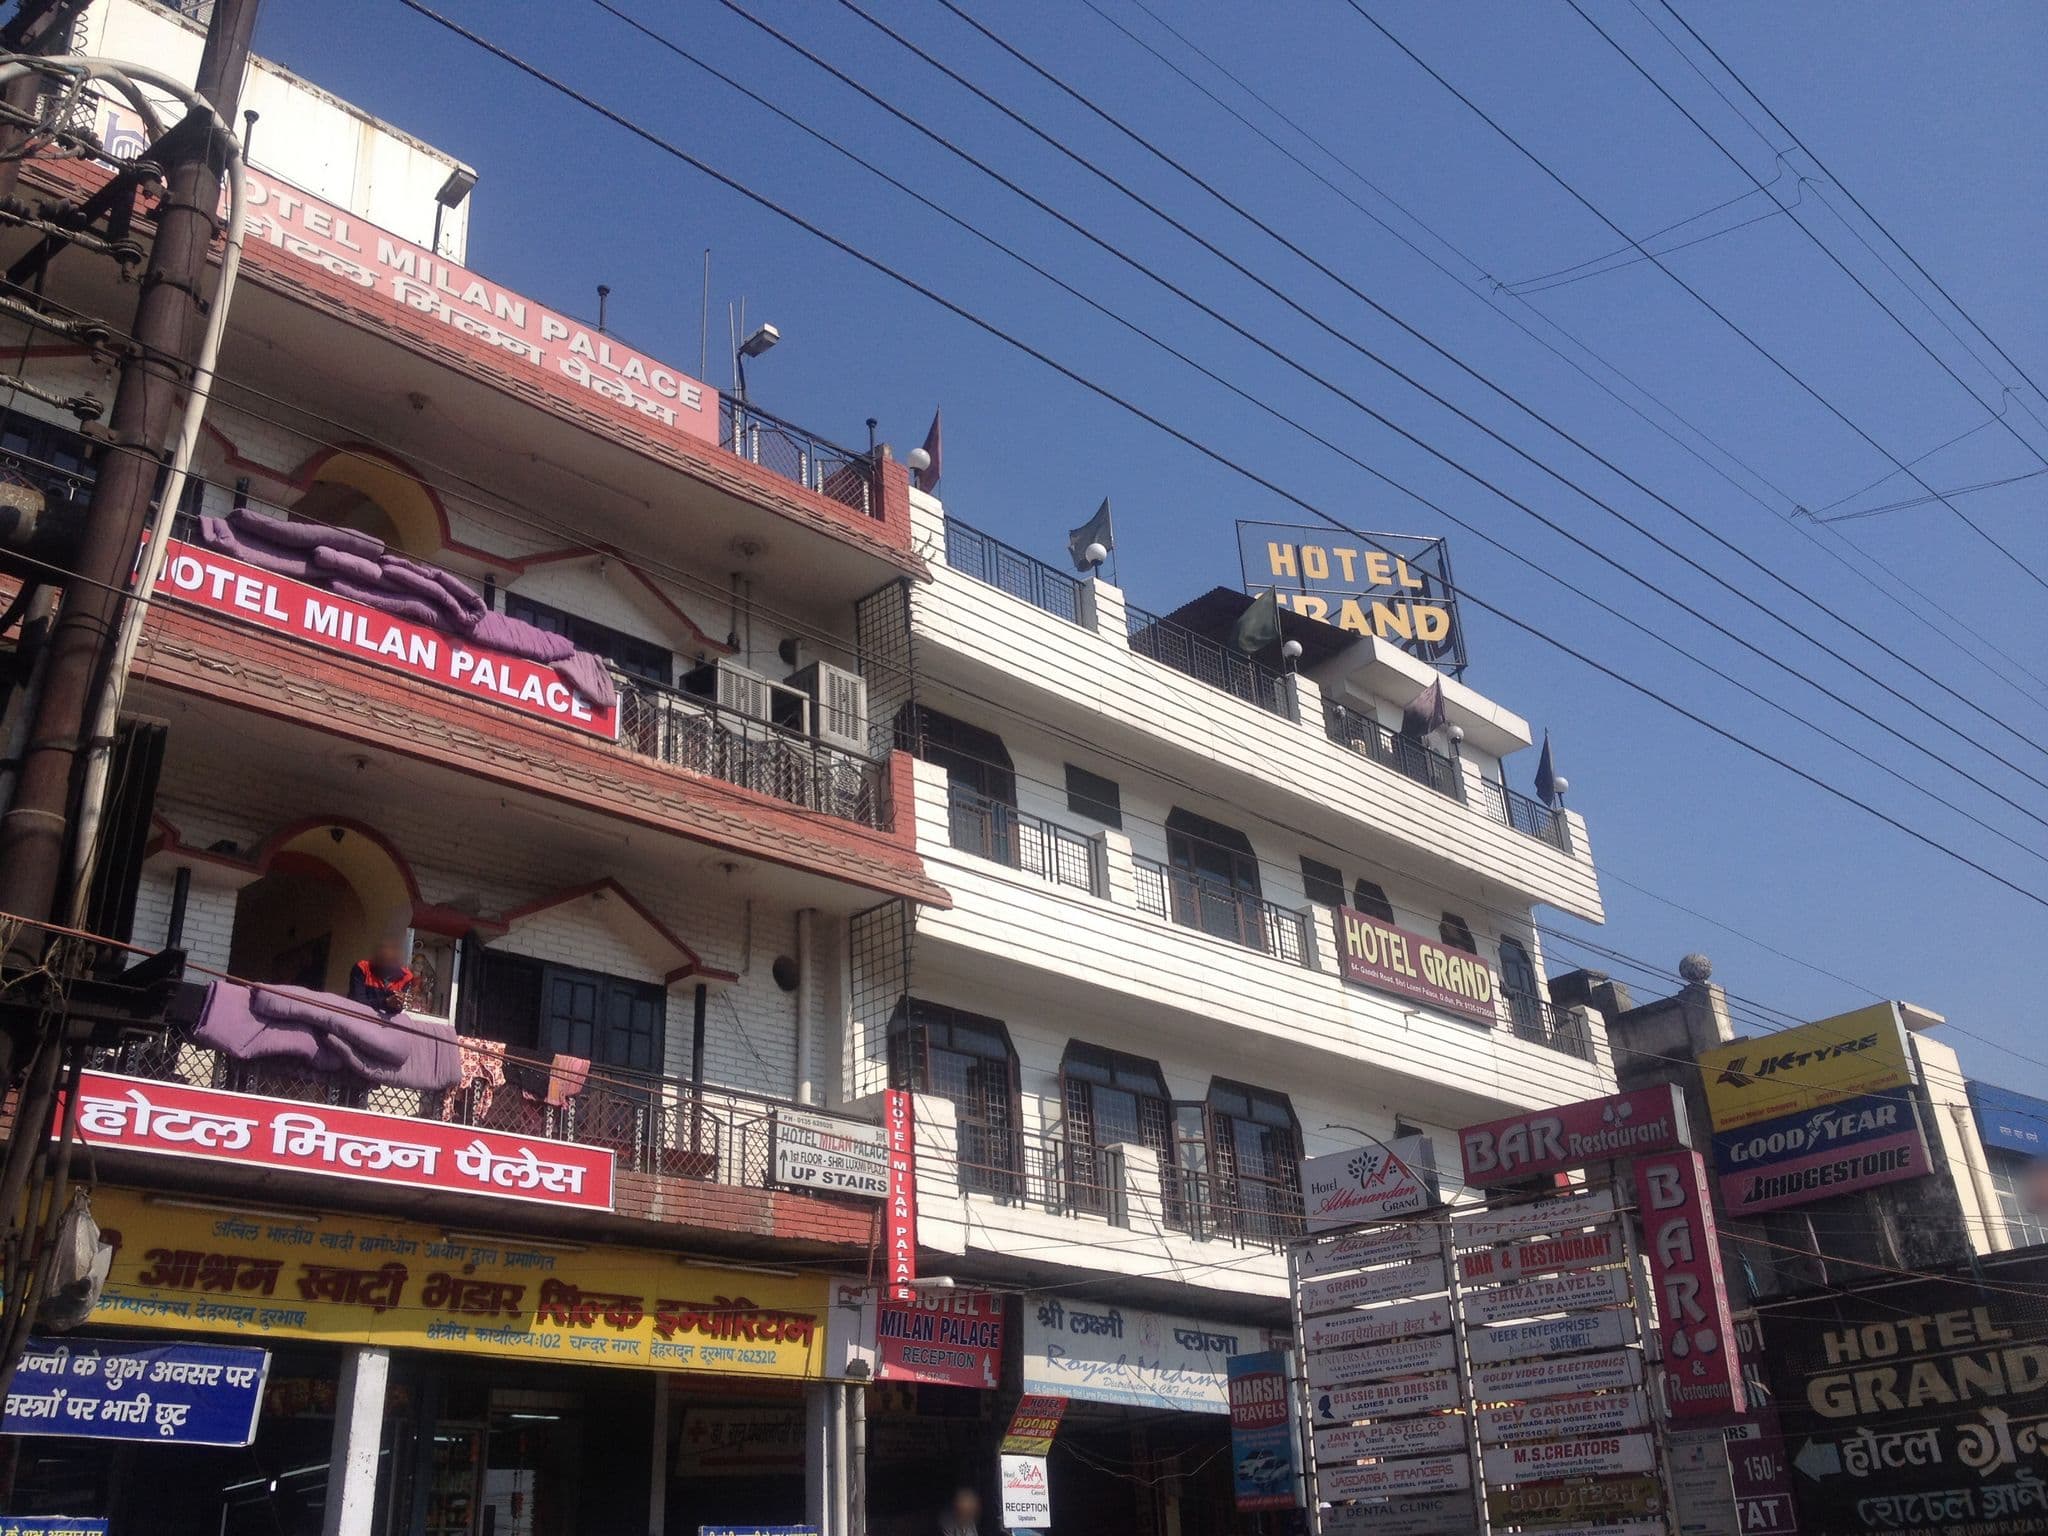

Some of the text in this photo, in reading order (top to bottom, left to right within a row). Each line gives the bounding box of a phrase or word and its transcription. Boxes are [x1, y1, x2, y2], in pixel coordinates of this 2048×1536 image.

[242, 176, 702, 413] OTEL MILAN PALACE
[391, 276, 547, 366] मिलन
[1267, 542, 1423, 588] HOTEL
[1254, 592, 1450, 642] RAND
[304, 599, 438, 671] MILAN
[450, 649, 592, 722] PALACE
[1344, 915, 1492, 1003] HOTEL GRAND
[80, 1090, 587, 1194] होटल मिलन पैलेस
[782, 1127, 817, 1149] HOTEL
[820, 1134, 853, 1153] MILAN
[853, 1140, 888, 1161] PALACE
[1464, 1117, 1669, 1174] BAR Restaurant
[790, 1150, 800, 1160] 1st
[801, 1152, 823, 1165] FLOOR
[829, 1156, 845, 1169] SHRI
[1743, 1146, 1911, 1204] BRIDGESTONE
[792, 1166, 888, 1192] UP STAIRS
[891, 1096, 909, 1299] HOTEL MILAN PALACE
[267, 1225, 316, 1247] भारतीय
[320, 1230, 356, 1252] खादी
[1646, 1163, 1707, 1324] BAR
[1464, 1233, 1612, 1278] BAR & RESTAURANT
[140, 1249, 285, 1296] आश्रम
[297, 1262, 409, 1312] खादी
[422, 1263, 527, 1318] भंडार
[1327, 1277, 1368, 1294] GRAND
[1488, 1275, 1606, 1304] SHIVA TRAVELS
[880, 1309, 1001, 1350] MILAN PALACE
[1037, 1300, 1064, 1330] श्री
[1070, 1309, 1124, 1338] लक्ष्मी
[1173, 1327, 1239, 1355] प्लाजा
[1489, 1317, 1600, 1344] VEER ENTERPRISES
[1550, 1333, 1591, 1351] SAFEWELL
[1823, 1306, 2014, 1365] HOTEL
[611, 1339, 642, 1355] नगर
[651, 1338, 695, 1363] देहरादून
[700, 1345, 737, 1366] दूरभाष
[902, 1345, 976, 1370] RECEPTION
[1047, 1343, 1128, 1382] Royal
[1317, 1340, 1443, 1366] UNIVERSAL ADVERTISERS
[73, 1349, 257, 1391] के शुभ अवसर पर
[1483, 1371, 1514, 1384] GOLDY
[1515, 1367, 1545, 1379] VIDEO
[1556, 1356, 1626, 1374] ELECTRONICS
[1670, 1370, 1730, 1403] Restaurant
[1807, 1345, 2048, 1418] GRAND
[1232, 1375, 1284, 1405] HARSH
[1333, 1380, 1449, 1405] CLASSIC HAIR DRESSER
[1352, 1400, 1384, 1410] LADIES
[1397, 1394, 1429, 1404] GENTS
[66, 1397, 100, 1421] पर
[101, 1393, 151, 1424] भारी
[155, 1404, 191, 1437] छूट
[1015, 1418, 1059, 1430] ROOMS
[1232, 1402, 1287, 1424] TRAVELS
[1490, 1397, 1630, 1424] DEV GARMENTS
[1545, 1418, 1561, 1426] AND
[1599, 1410, 1625, 1419] ITEMS
[1327, 1430, 1366, 1443] JANTA
[1371, 1422, 1425, 1438] PLASTIC
[1842, 1425, 1943, 1478] होटल
[1330, 1473, 1389, 1488] JAGDAMBA
[1005, 1502, 1048, 1513] RECEPTION
[1346, 1499, 1444, 1519] DENTAL CLINIC
